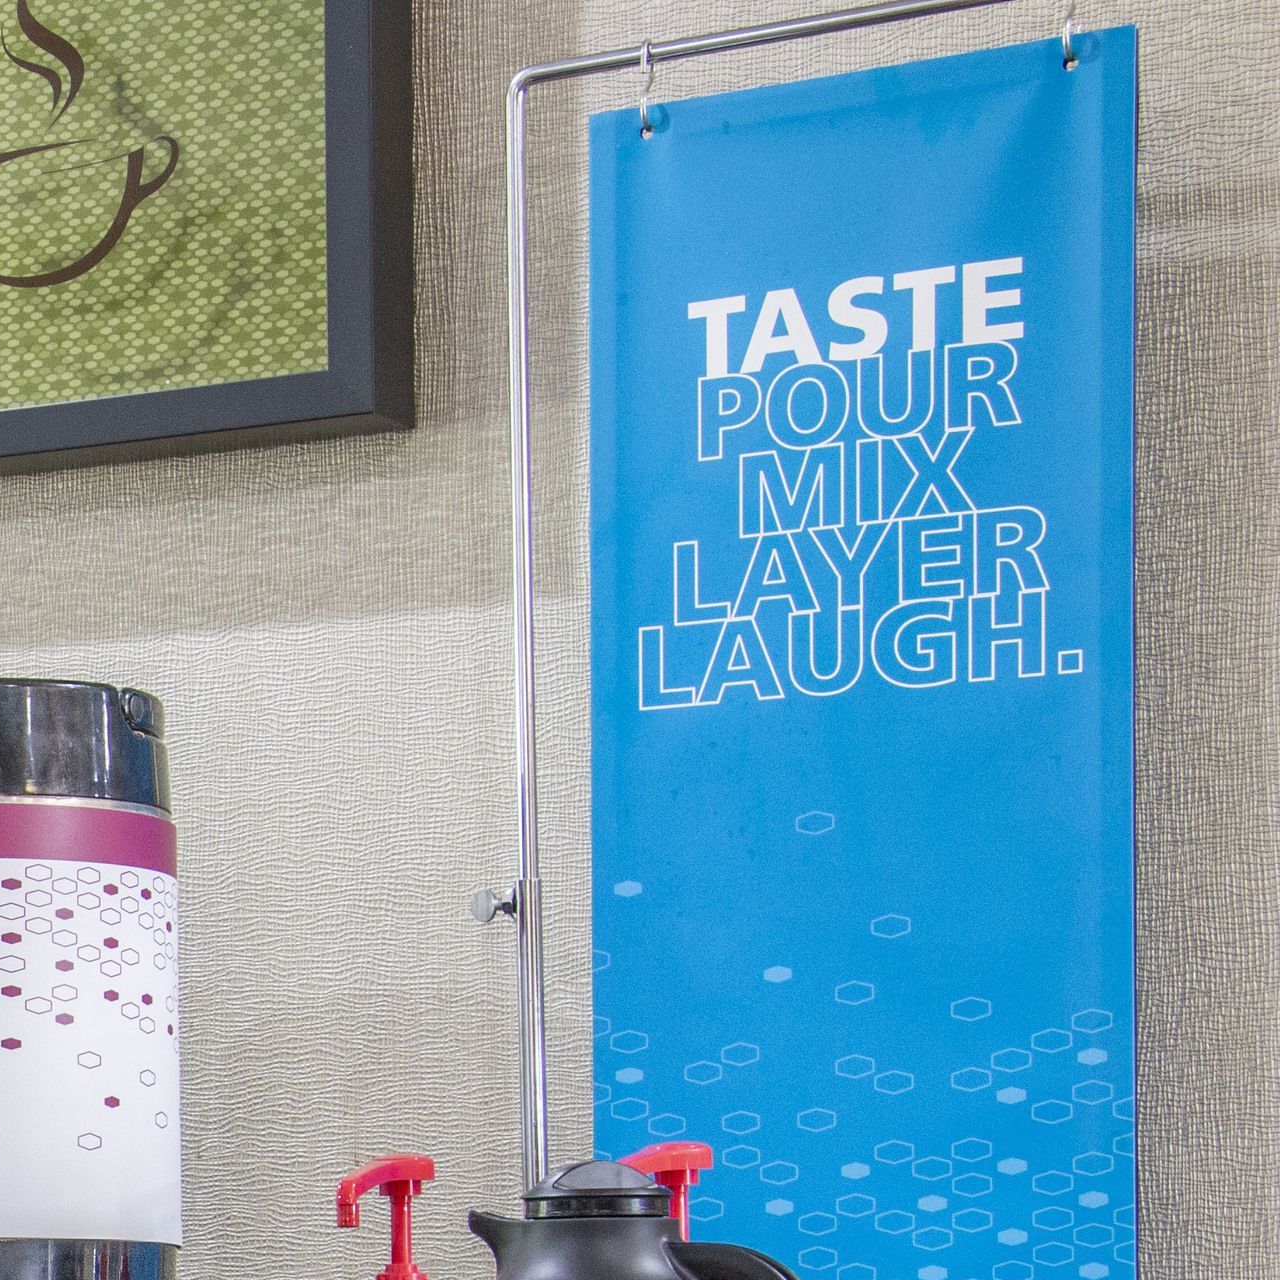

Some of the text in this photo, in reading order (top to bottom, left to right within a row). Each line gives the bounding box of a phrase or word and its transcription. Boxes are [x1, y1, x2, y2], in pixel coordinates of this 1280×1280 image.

[687, 257, 1024, 378] TASTE
[697, 340, 1022, 461] POUR
[739, 427, 977, 539] MIX
[673, 505, 1050, 626] LAYER
[638, 588, 1083, 710] LAUGH.
